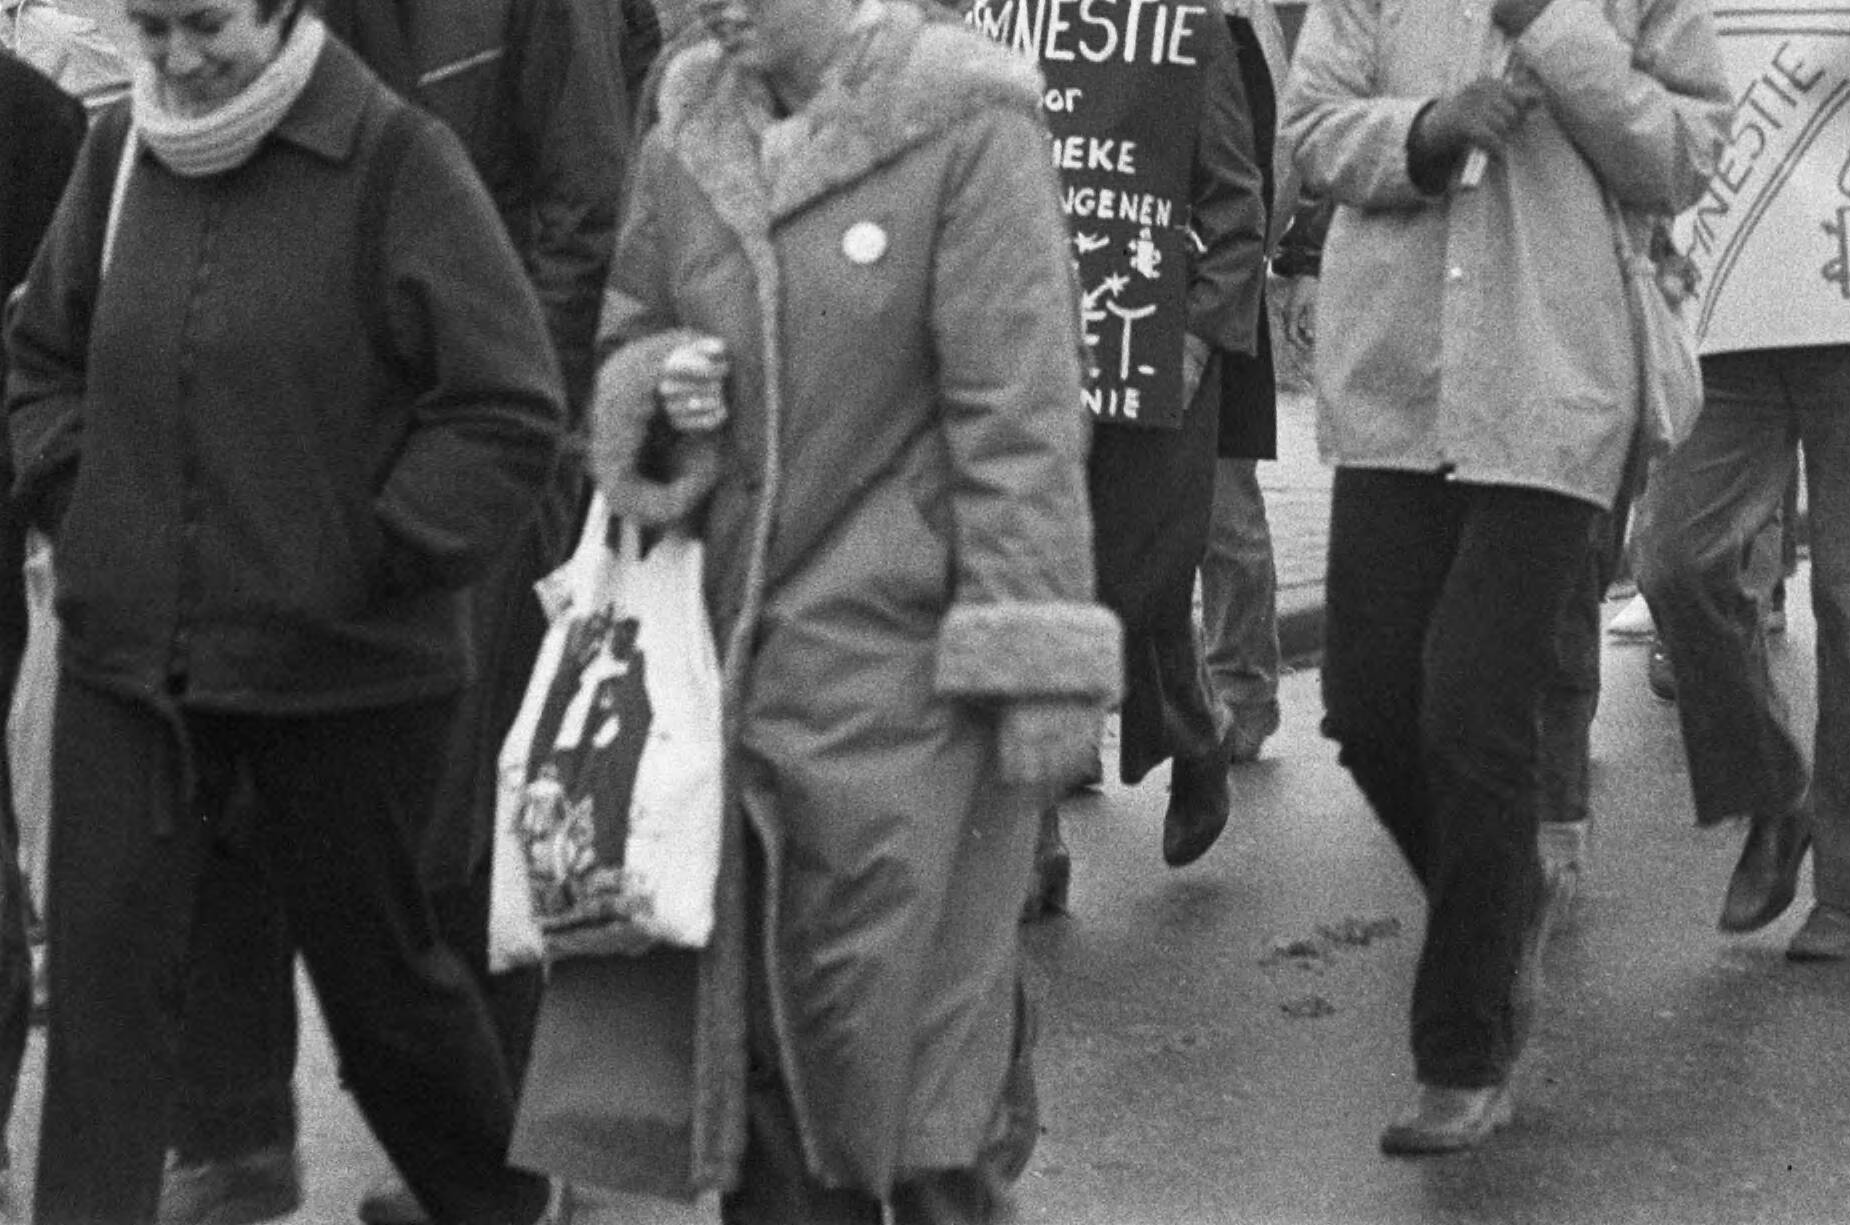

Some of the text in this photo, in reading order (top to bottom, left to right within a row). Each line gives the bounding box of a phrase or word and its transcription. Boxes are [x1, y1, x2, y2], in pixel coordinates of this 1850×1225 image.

[1053, 136, 1137, 175] IEKE
[1060, 185, 1172, 227] NGENEN
[1079, 387, 1141, 420] NIE
